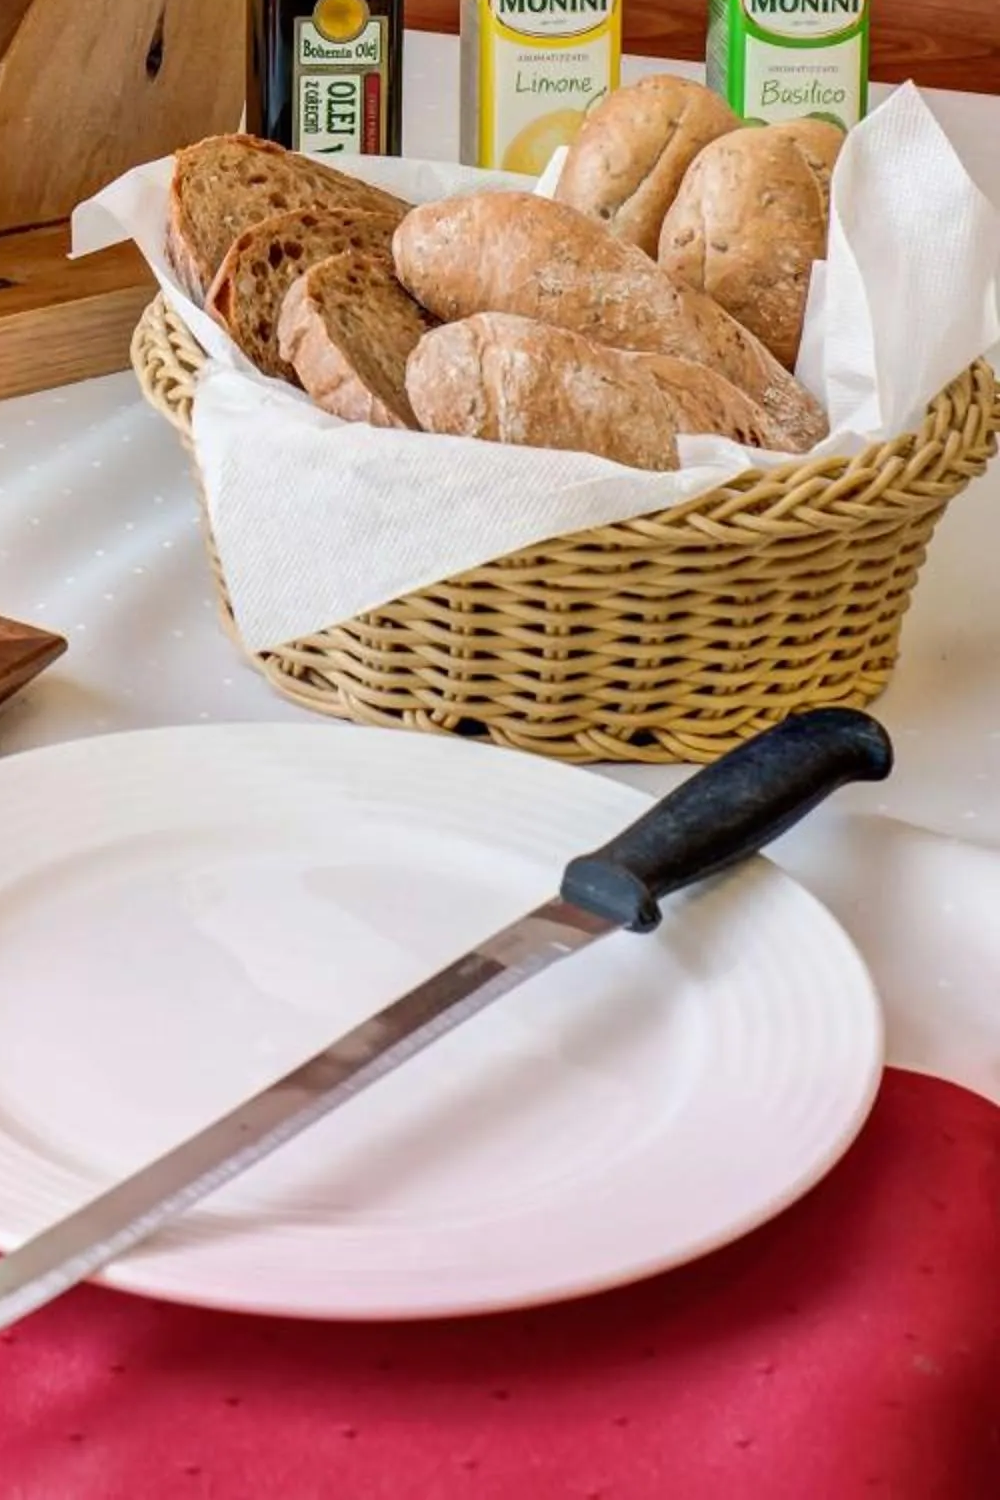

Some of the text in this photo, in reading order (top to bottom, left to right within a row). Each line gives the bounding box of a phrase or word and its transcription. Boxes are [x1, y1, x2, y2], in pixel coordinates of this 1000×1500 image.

[303, 39, 378, 60] Bohemia Olej
[515, 71, 592, 94] Limone
[761, 79, 846, 106] Basilico
[327, 81, 357, 135] OLEJ
